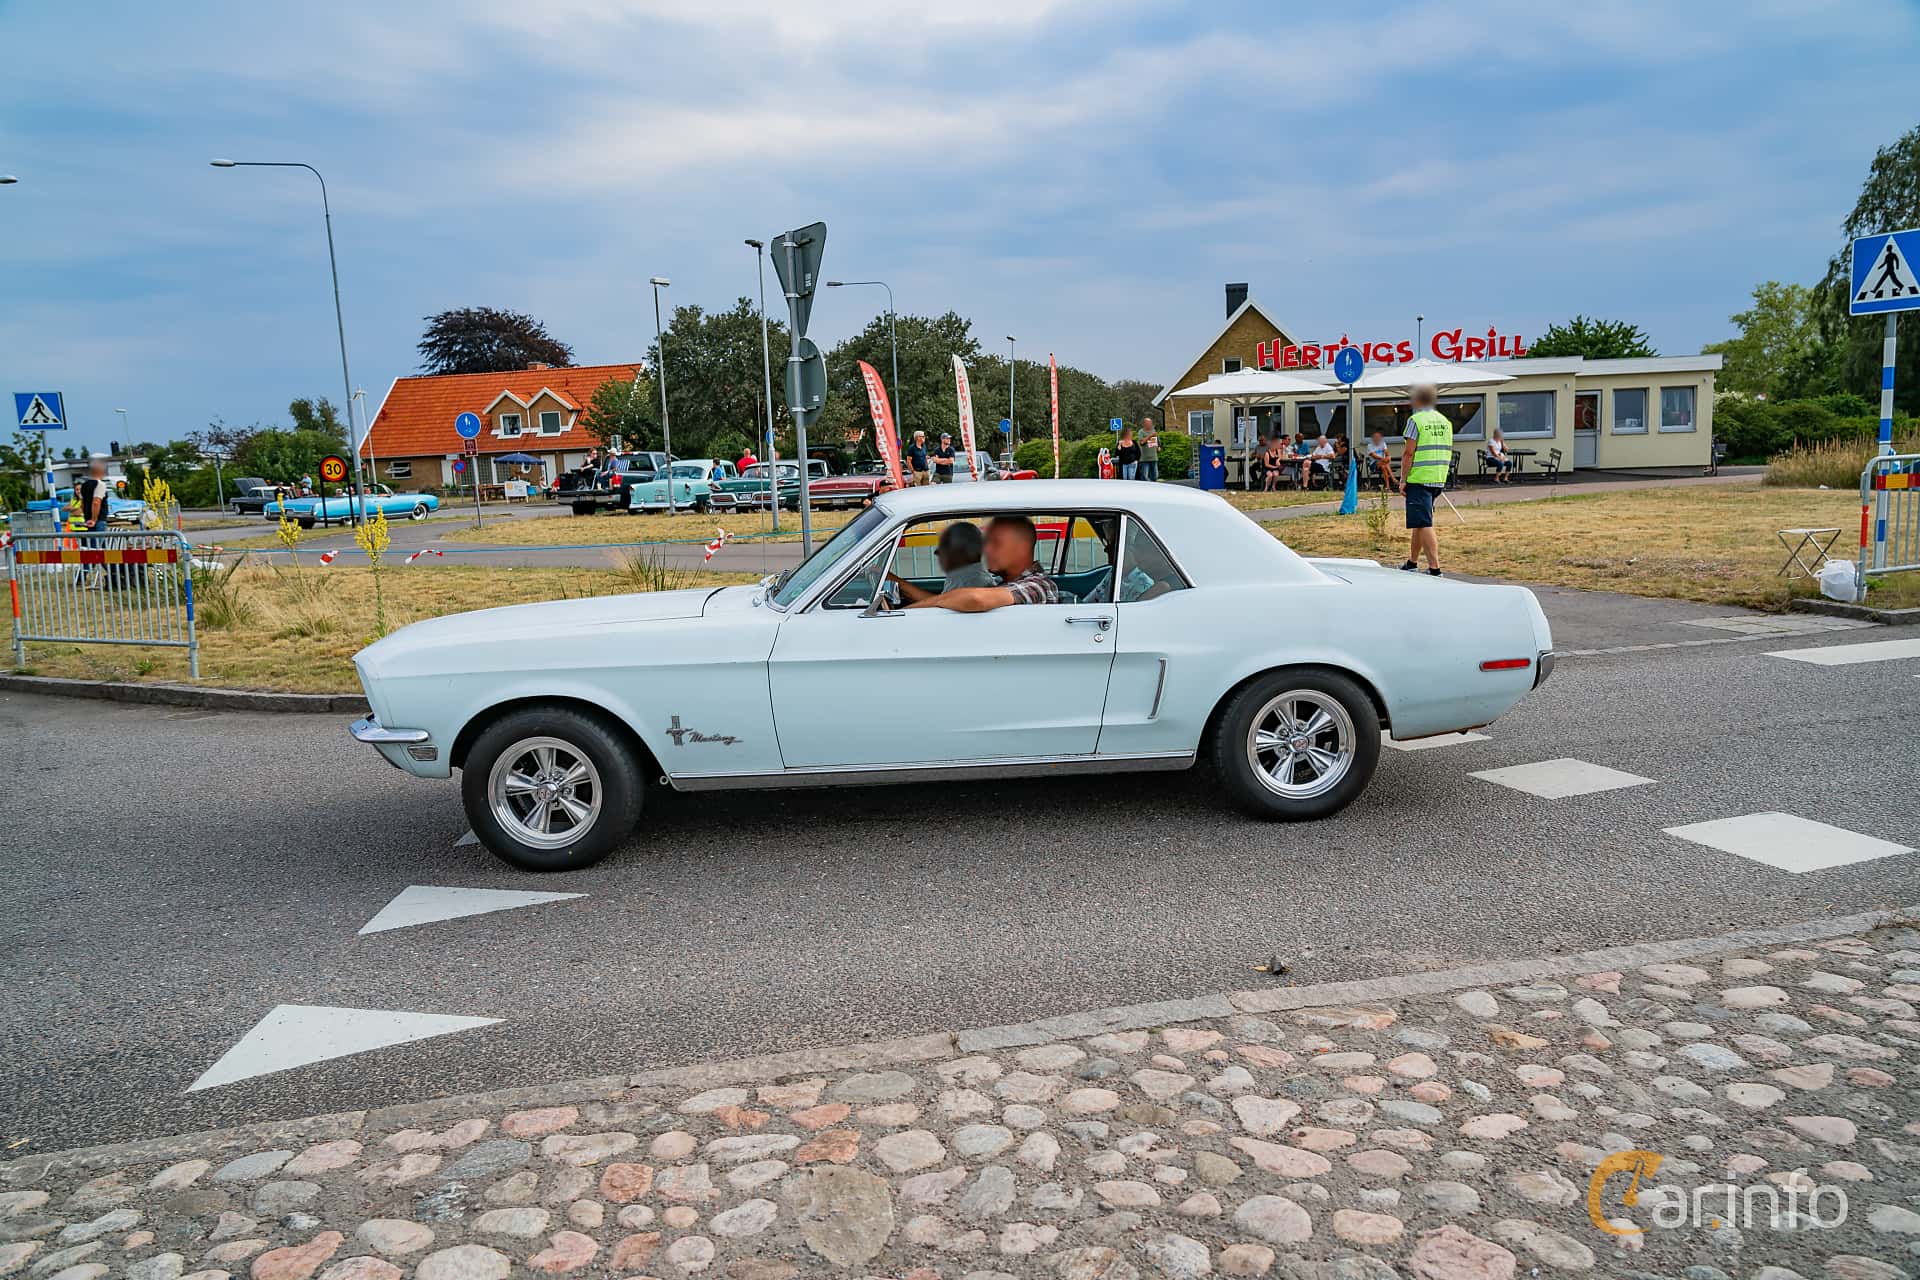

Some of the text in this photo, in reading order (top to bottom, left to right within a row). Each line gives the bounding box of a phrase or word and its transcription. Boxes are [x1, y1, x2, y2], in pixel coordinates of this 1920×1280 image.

[1431, 326, 1527, 362] GRILL
[326, 463, 342, 475] 30
[688, 731, 744, 746] Mustang
